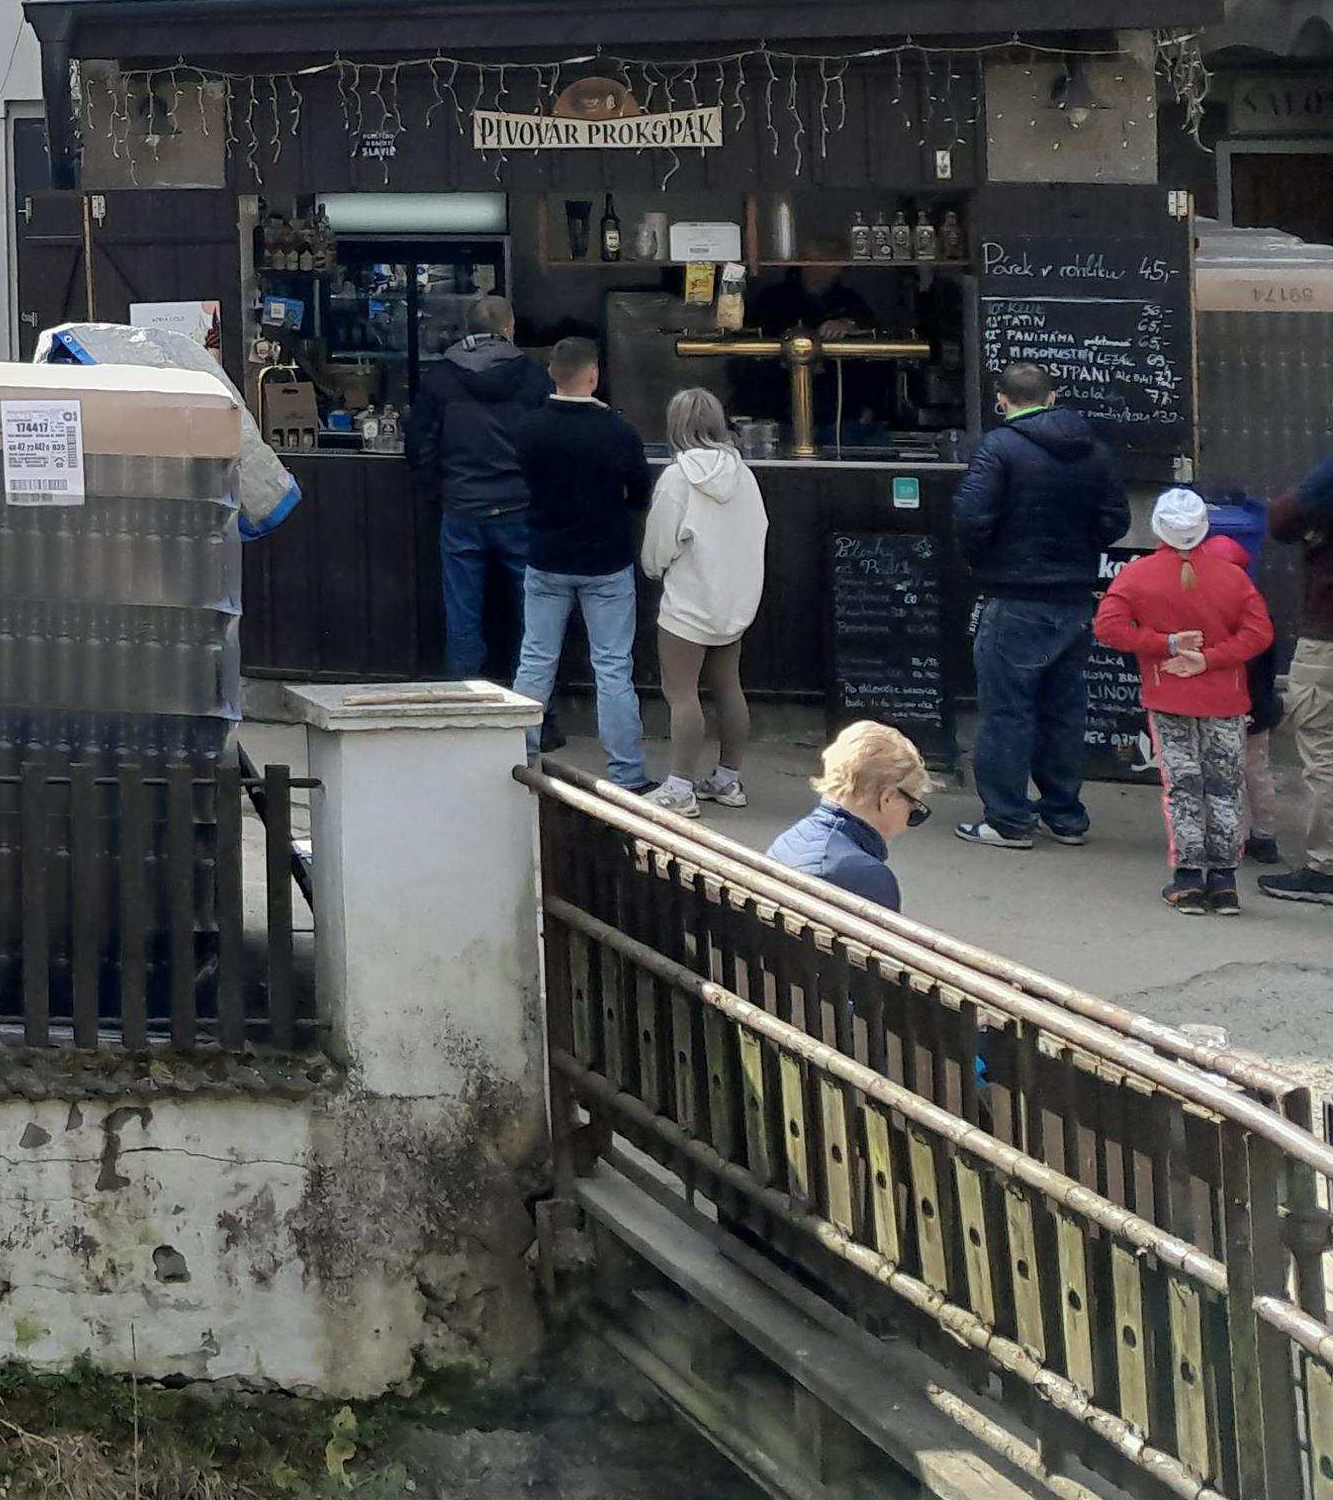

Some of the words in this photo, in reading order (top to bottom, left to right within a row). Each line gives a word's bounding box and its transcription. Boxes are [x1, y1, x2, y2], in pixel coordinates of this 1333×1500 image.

[481, 117, 580, 145] PIVOVAR
[587, 112, 715, 145] PROKOPÁK
[982, 241, 1034, 277] Párek
[15, 422, 49, 433] 174417
